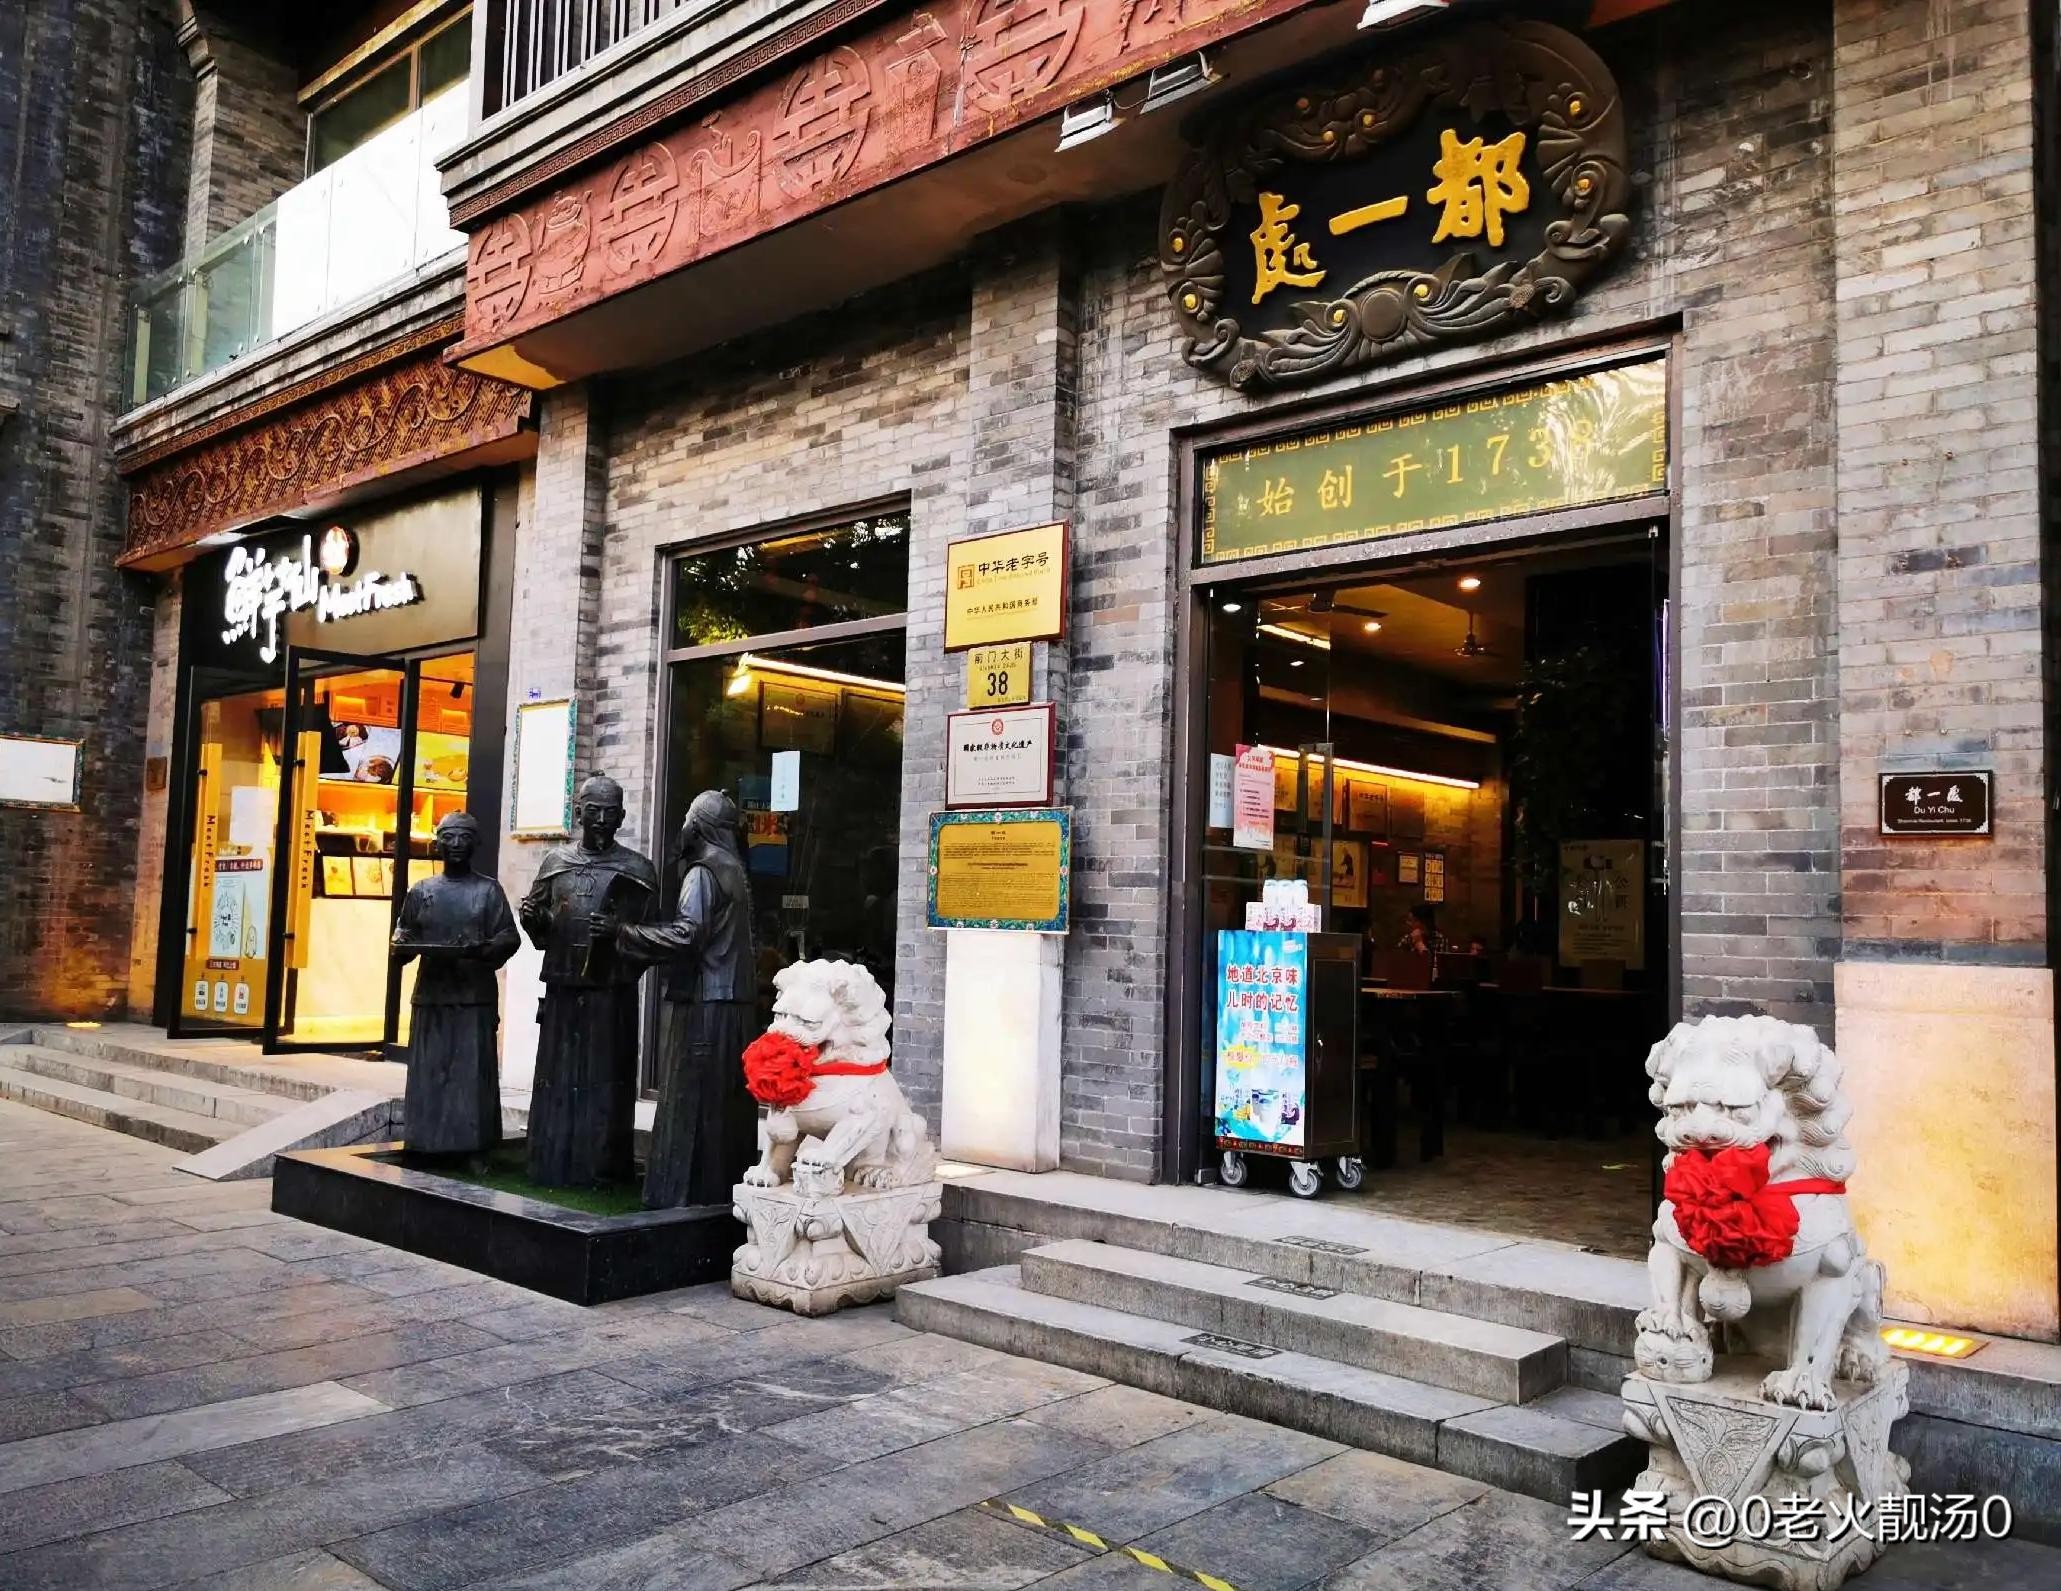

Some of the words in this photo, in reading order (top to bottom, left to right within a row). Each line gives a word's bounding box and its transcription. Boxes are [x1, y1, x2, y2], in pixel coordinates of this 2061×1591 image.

[978, 551, 1049, 576] 中华老字号
[974, 647, 1023, 664] 前门大街
[987, 671, 1009, 696] 38
[1913, 806, 1926, 814] Du
[1927, 806, 1936, 814] Yi
[1937, 805, 1955, 814] Chu
[1227, 965, 1299, 985] 地道北京味
[1226, 990, 1298, 1012] 儿时的记忆
